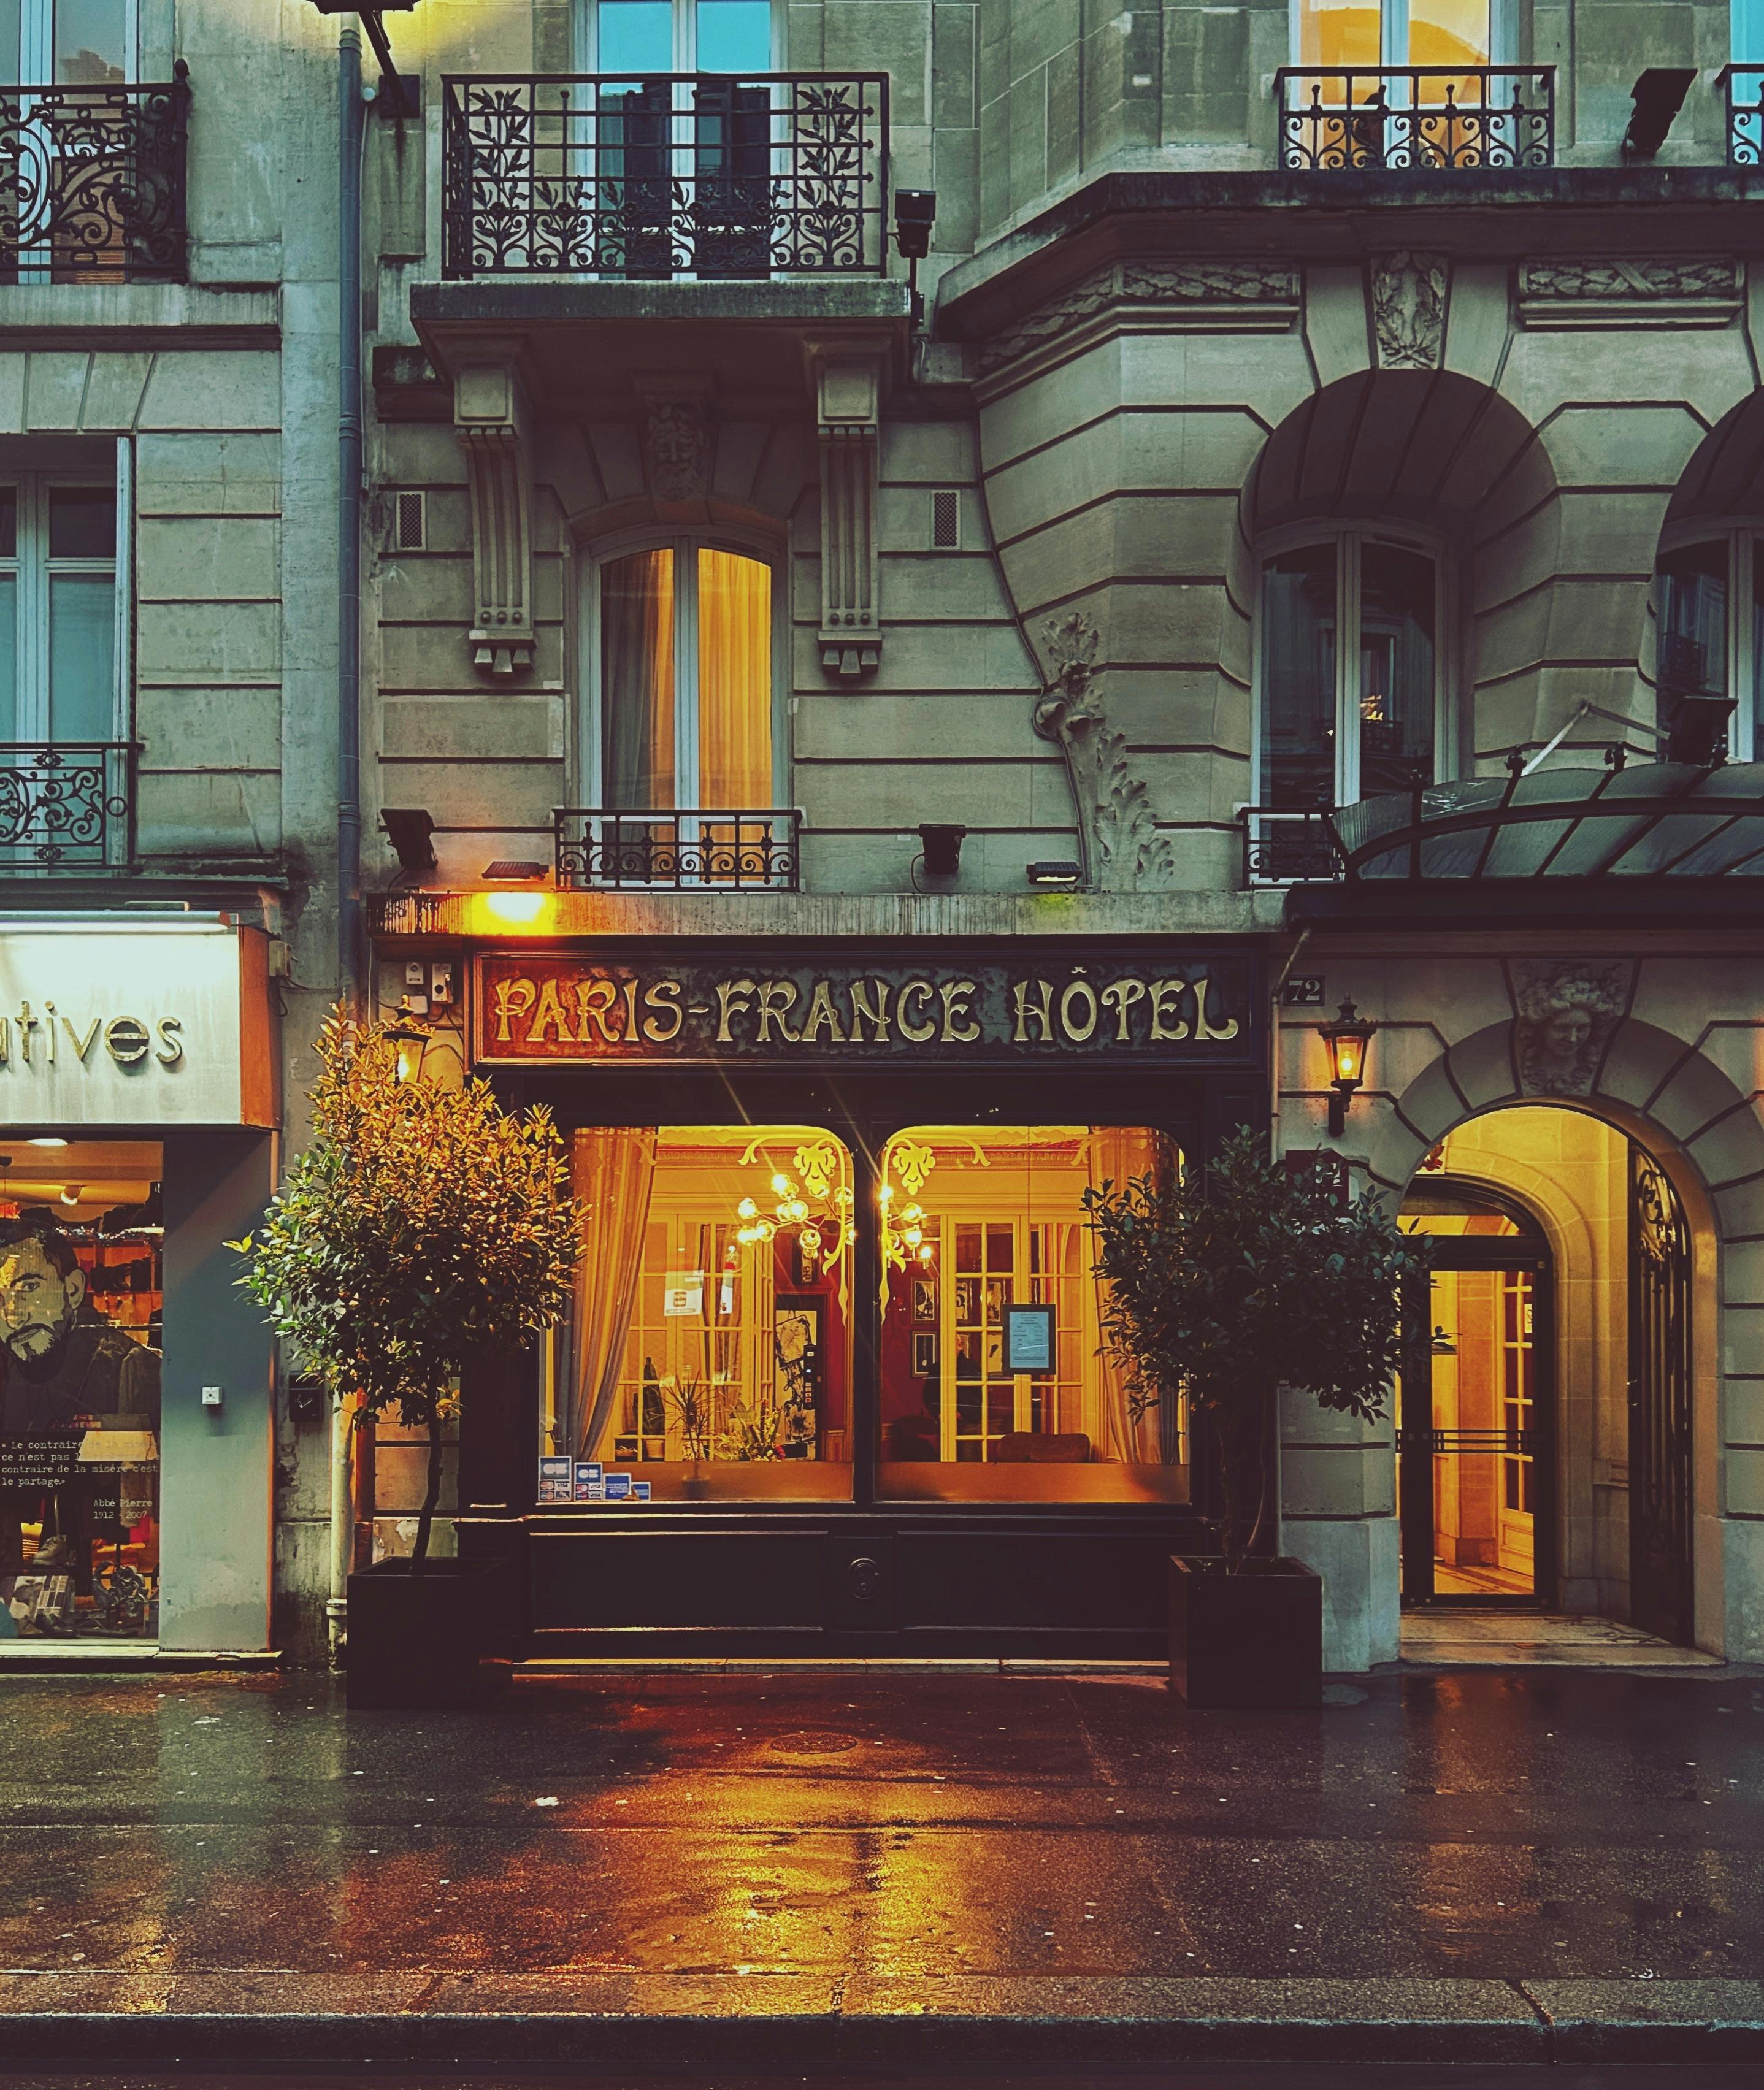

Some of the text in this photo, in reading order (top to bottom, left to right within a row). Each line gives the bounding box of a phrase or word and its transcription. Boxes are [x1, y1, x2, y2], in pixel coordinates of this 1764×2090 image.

[1289, 979, 1321, 1001] 72
[494, 978, 980, 1042] PARIS-FRANCE
[0, 1001, 182, 1062] tives
[50, 1454, 69, 1463] pas
[93, 1498, 153, 1507] Abbé Pierre
[126, 1510, 147, 1519] 2007
